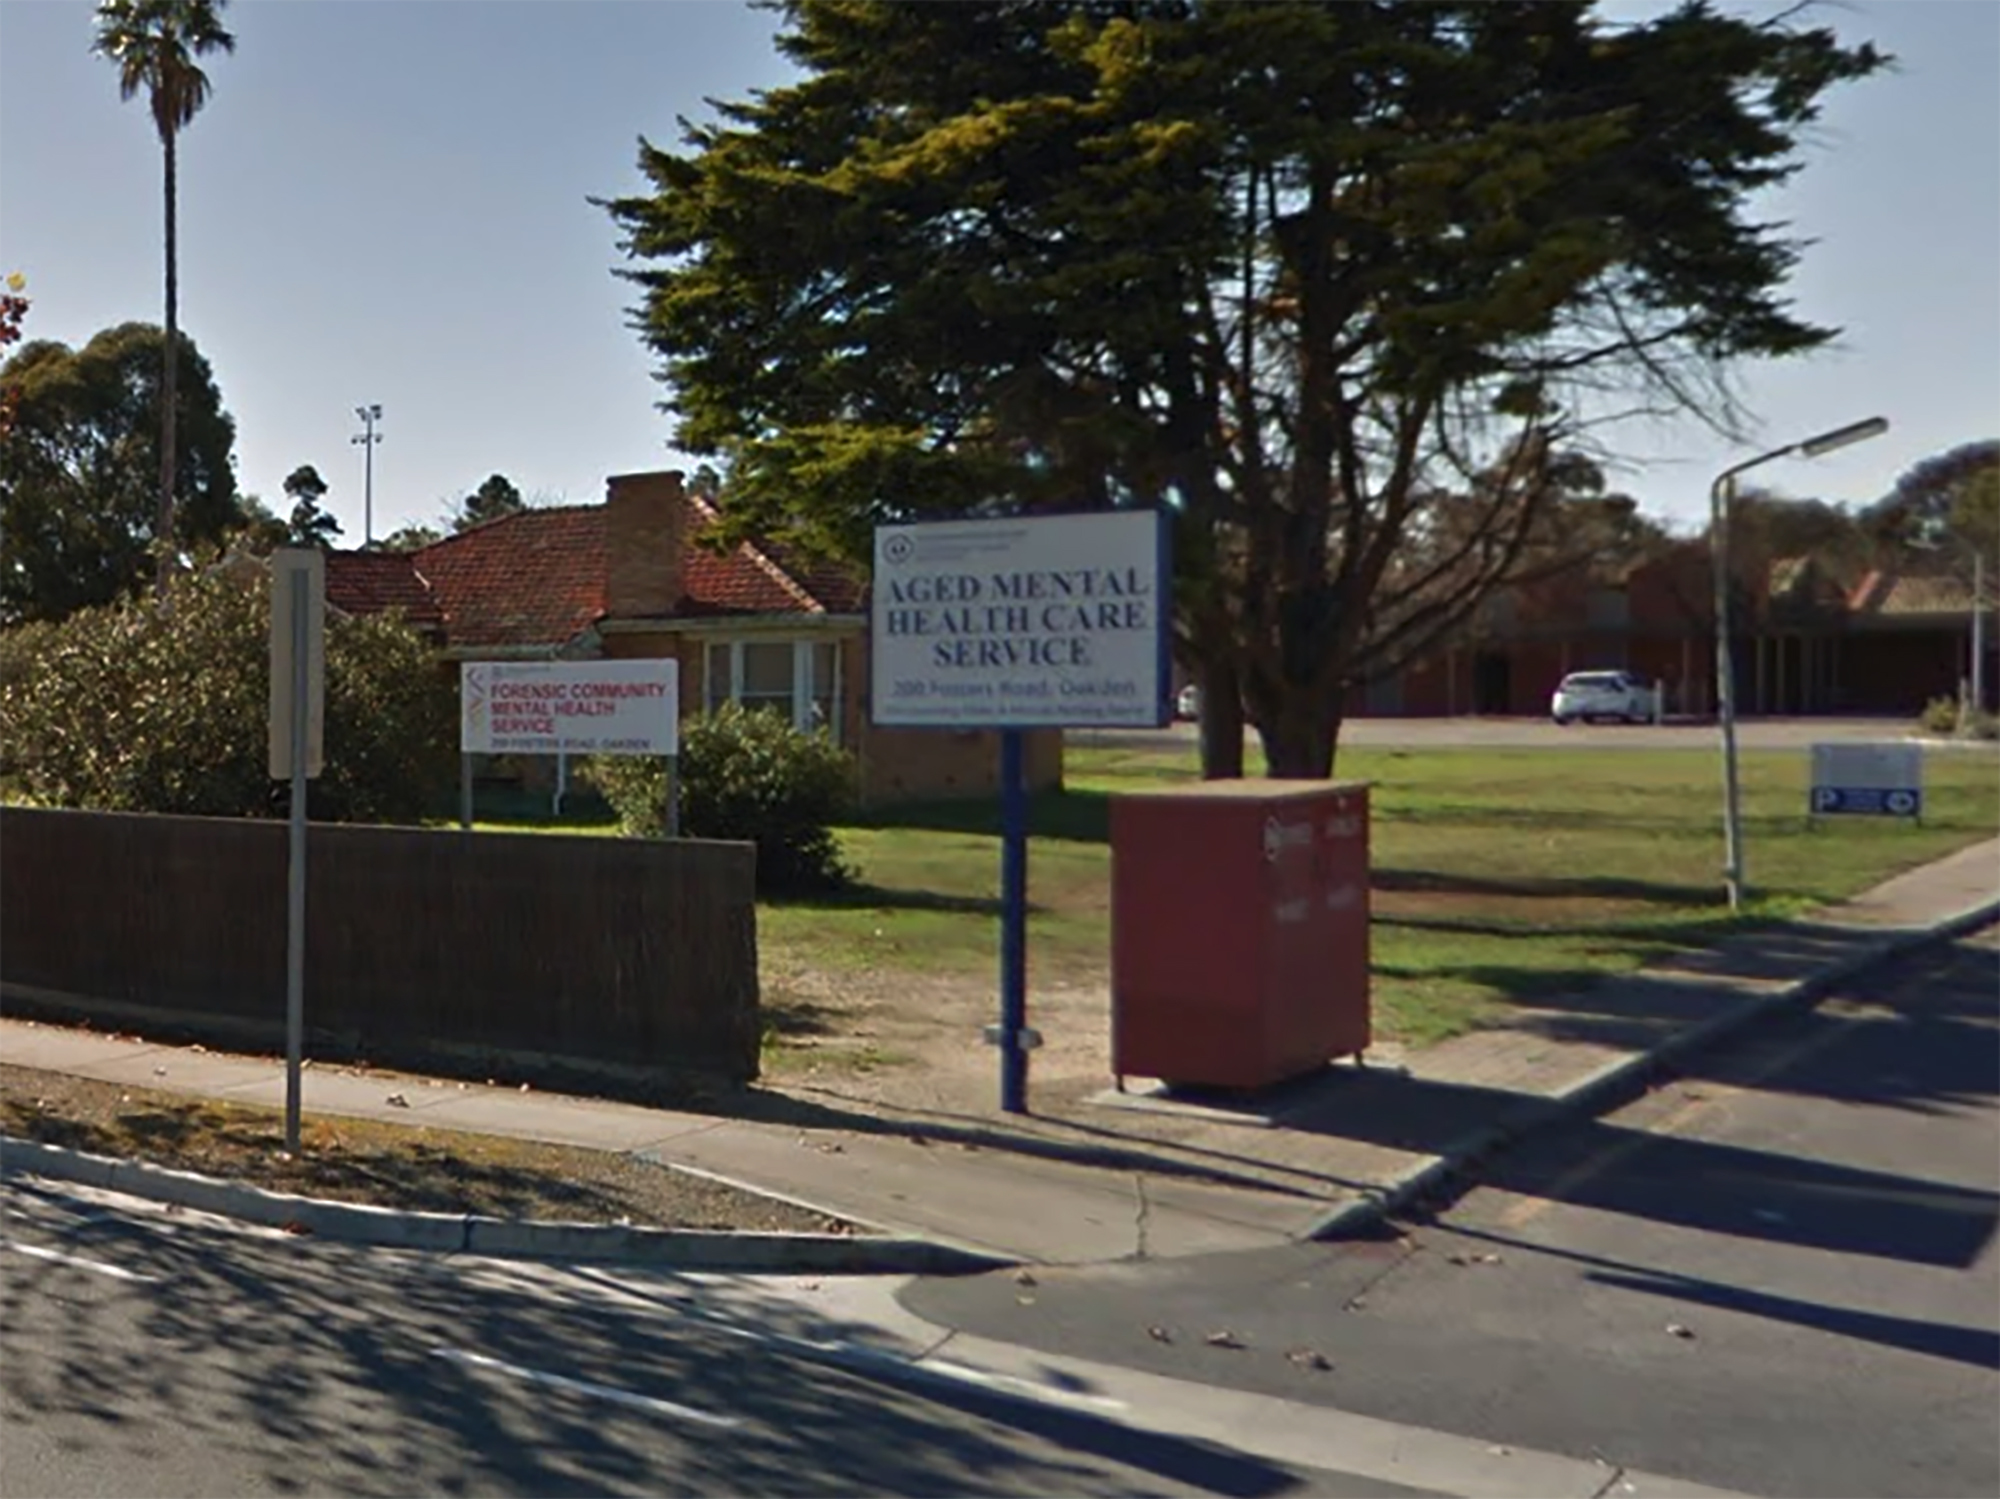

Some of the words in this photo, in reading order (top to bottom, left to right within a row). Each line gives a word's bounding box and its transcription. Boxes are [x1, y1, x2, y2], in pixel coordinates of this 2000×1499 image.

[889, 575, 982, 604] AGED
[991, 567, 1149, 600] MENTAL
[887, 604, 1030, 635] HEALTH
[1041, 601, 1148, 633] CARE
[933, 636, 1093, 668] SERVICE
[491, 683, 567, 699] FORENSIC
[570, 682, 667, 698] COMMUNITY
[490, 701, 549, 716] MENTAL
[554, 701, 616, 717] HEALTH
[490, 718, 555, 734] SERVICE
